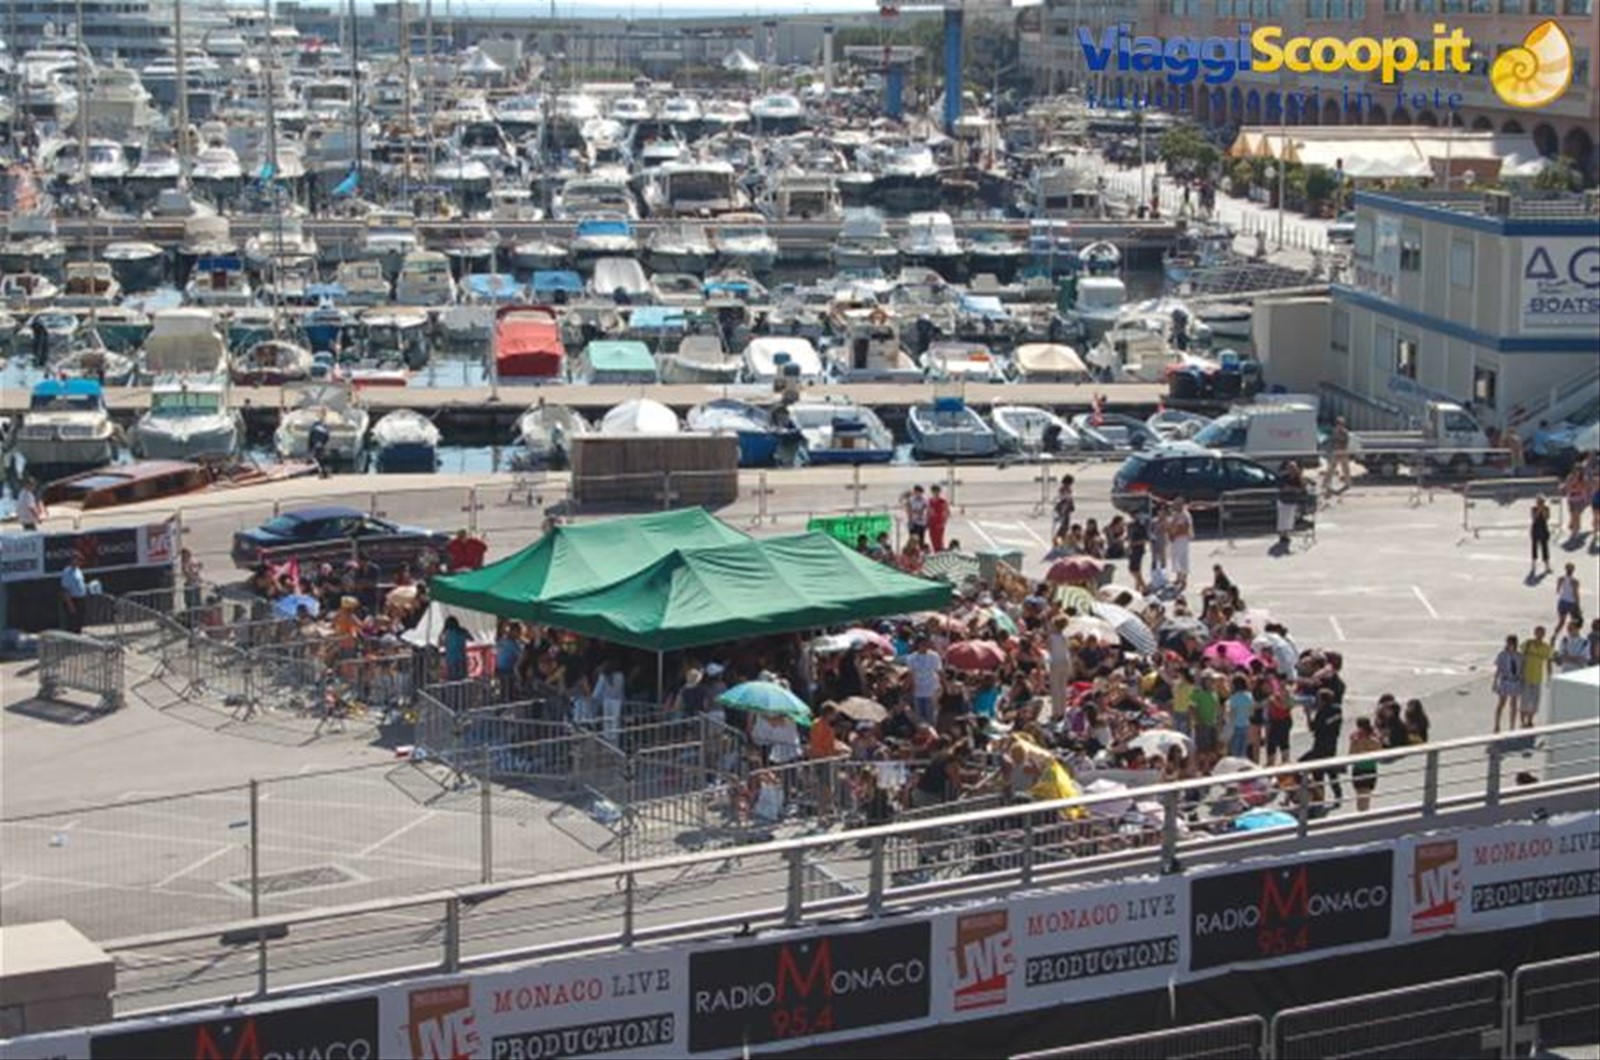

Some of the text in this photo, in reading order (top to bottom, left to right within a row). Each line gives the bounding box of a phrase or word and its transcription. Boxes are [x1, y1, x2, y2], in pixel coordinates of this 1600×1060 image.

[1474, 838, 1552, 866] MONACO
[1560, 831, 1600, 854] LIVE
[1472, 870, 1600, 912] PRODUCTIONS
[1028, 903, 1119, 937] MONACO
[1127, 894, 1176, 921] LIVE
[1195, 905, 1261, 936] RADIO
[696, 936, 925, 1013] RADIO MONACO
[1026, 938, 1179, 985] PRODUCTIONS
[493, 978, 604, 1013] MONACO
[611, 968, 671, 998] LIVE
[494, 1016, 675, 1060] PRODUCTIONS
[771, 1004, 836, 1037] 95.4
